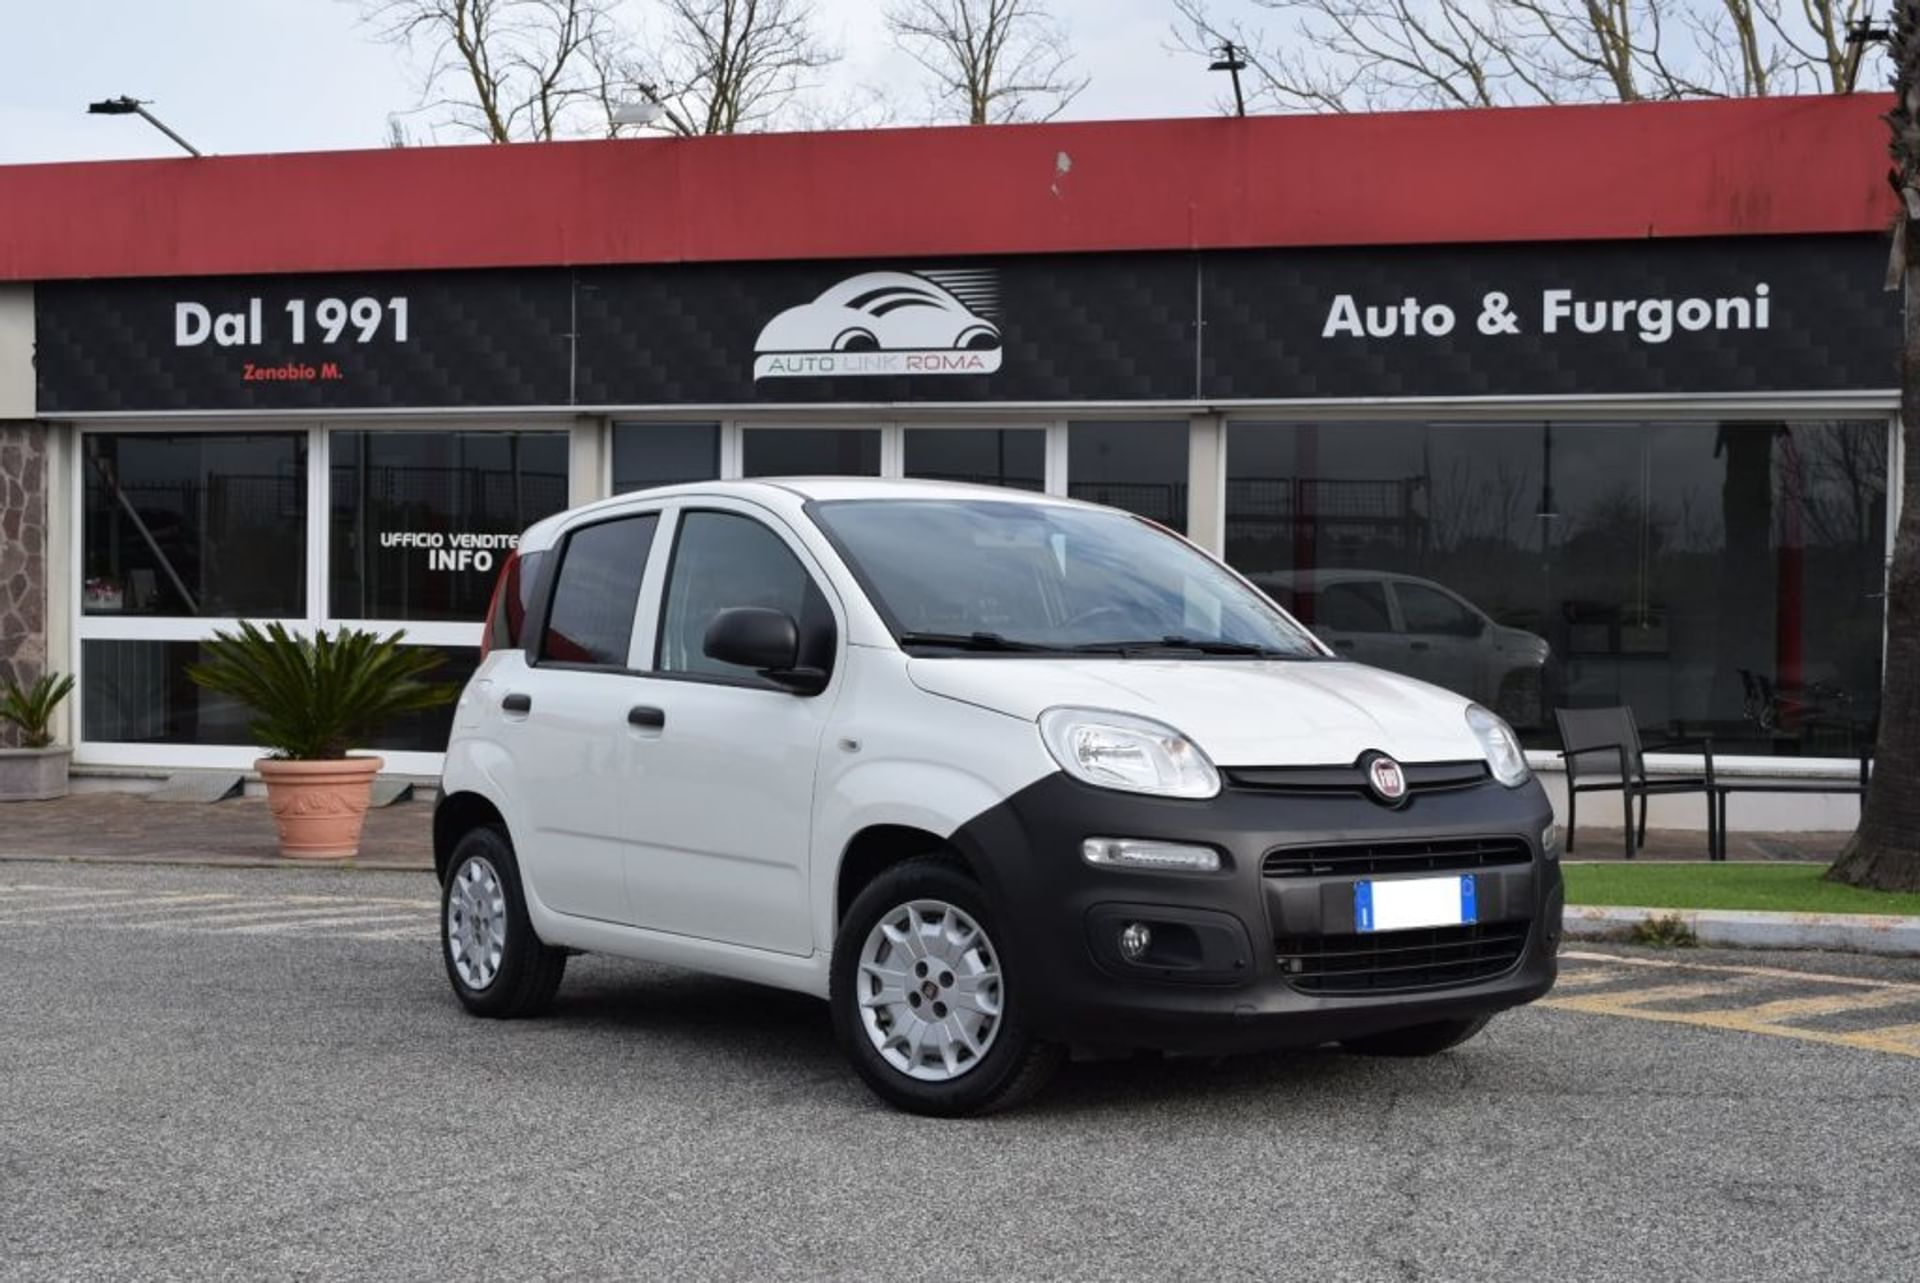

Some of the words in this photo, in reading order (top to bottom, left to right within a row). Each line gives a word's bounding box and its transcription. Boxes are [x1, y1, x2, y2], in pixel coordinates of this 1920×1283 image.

[175, 298, 262, 346] Dal
[285, 297, 408, 344] 1991
[1322, 294, 1456, 338] Auto
[1476, 291, 1521, 335] &
[1543, 283, 1770, 343] Furgoni
[243, 362, 316, 381] Zenobio
[321, 363, 343, 379] M.
[768, 356, 835, 372] AUTO
[842, 355, 898, 371] LINK
[906, 355, 985, 370] ROMA
[380, 532, 444, 547] UFFICIO
[448, 534, 519, 549] VENDITE
[429, 549, 493, 571] INFO
